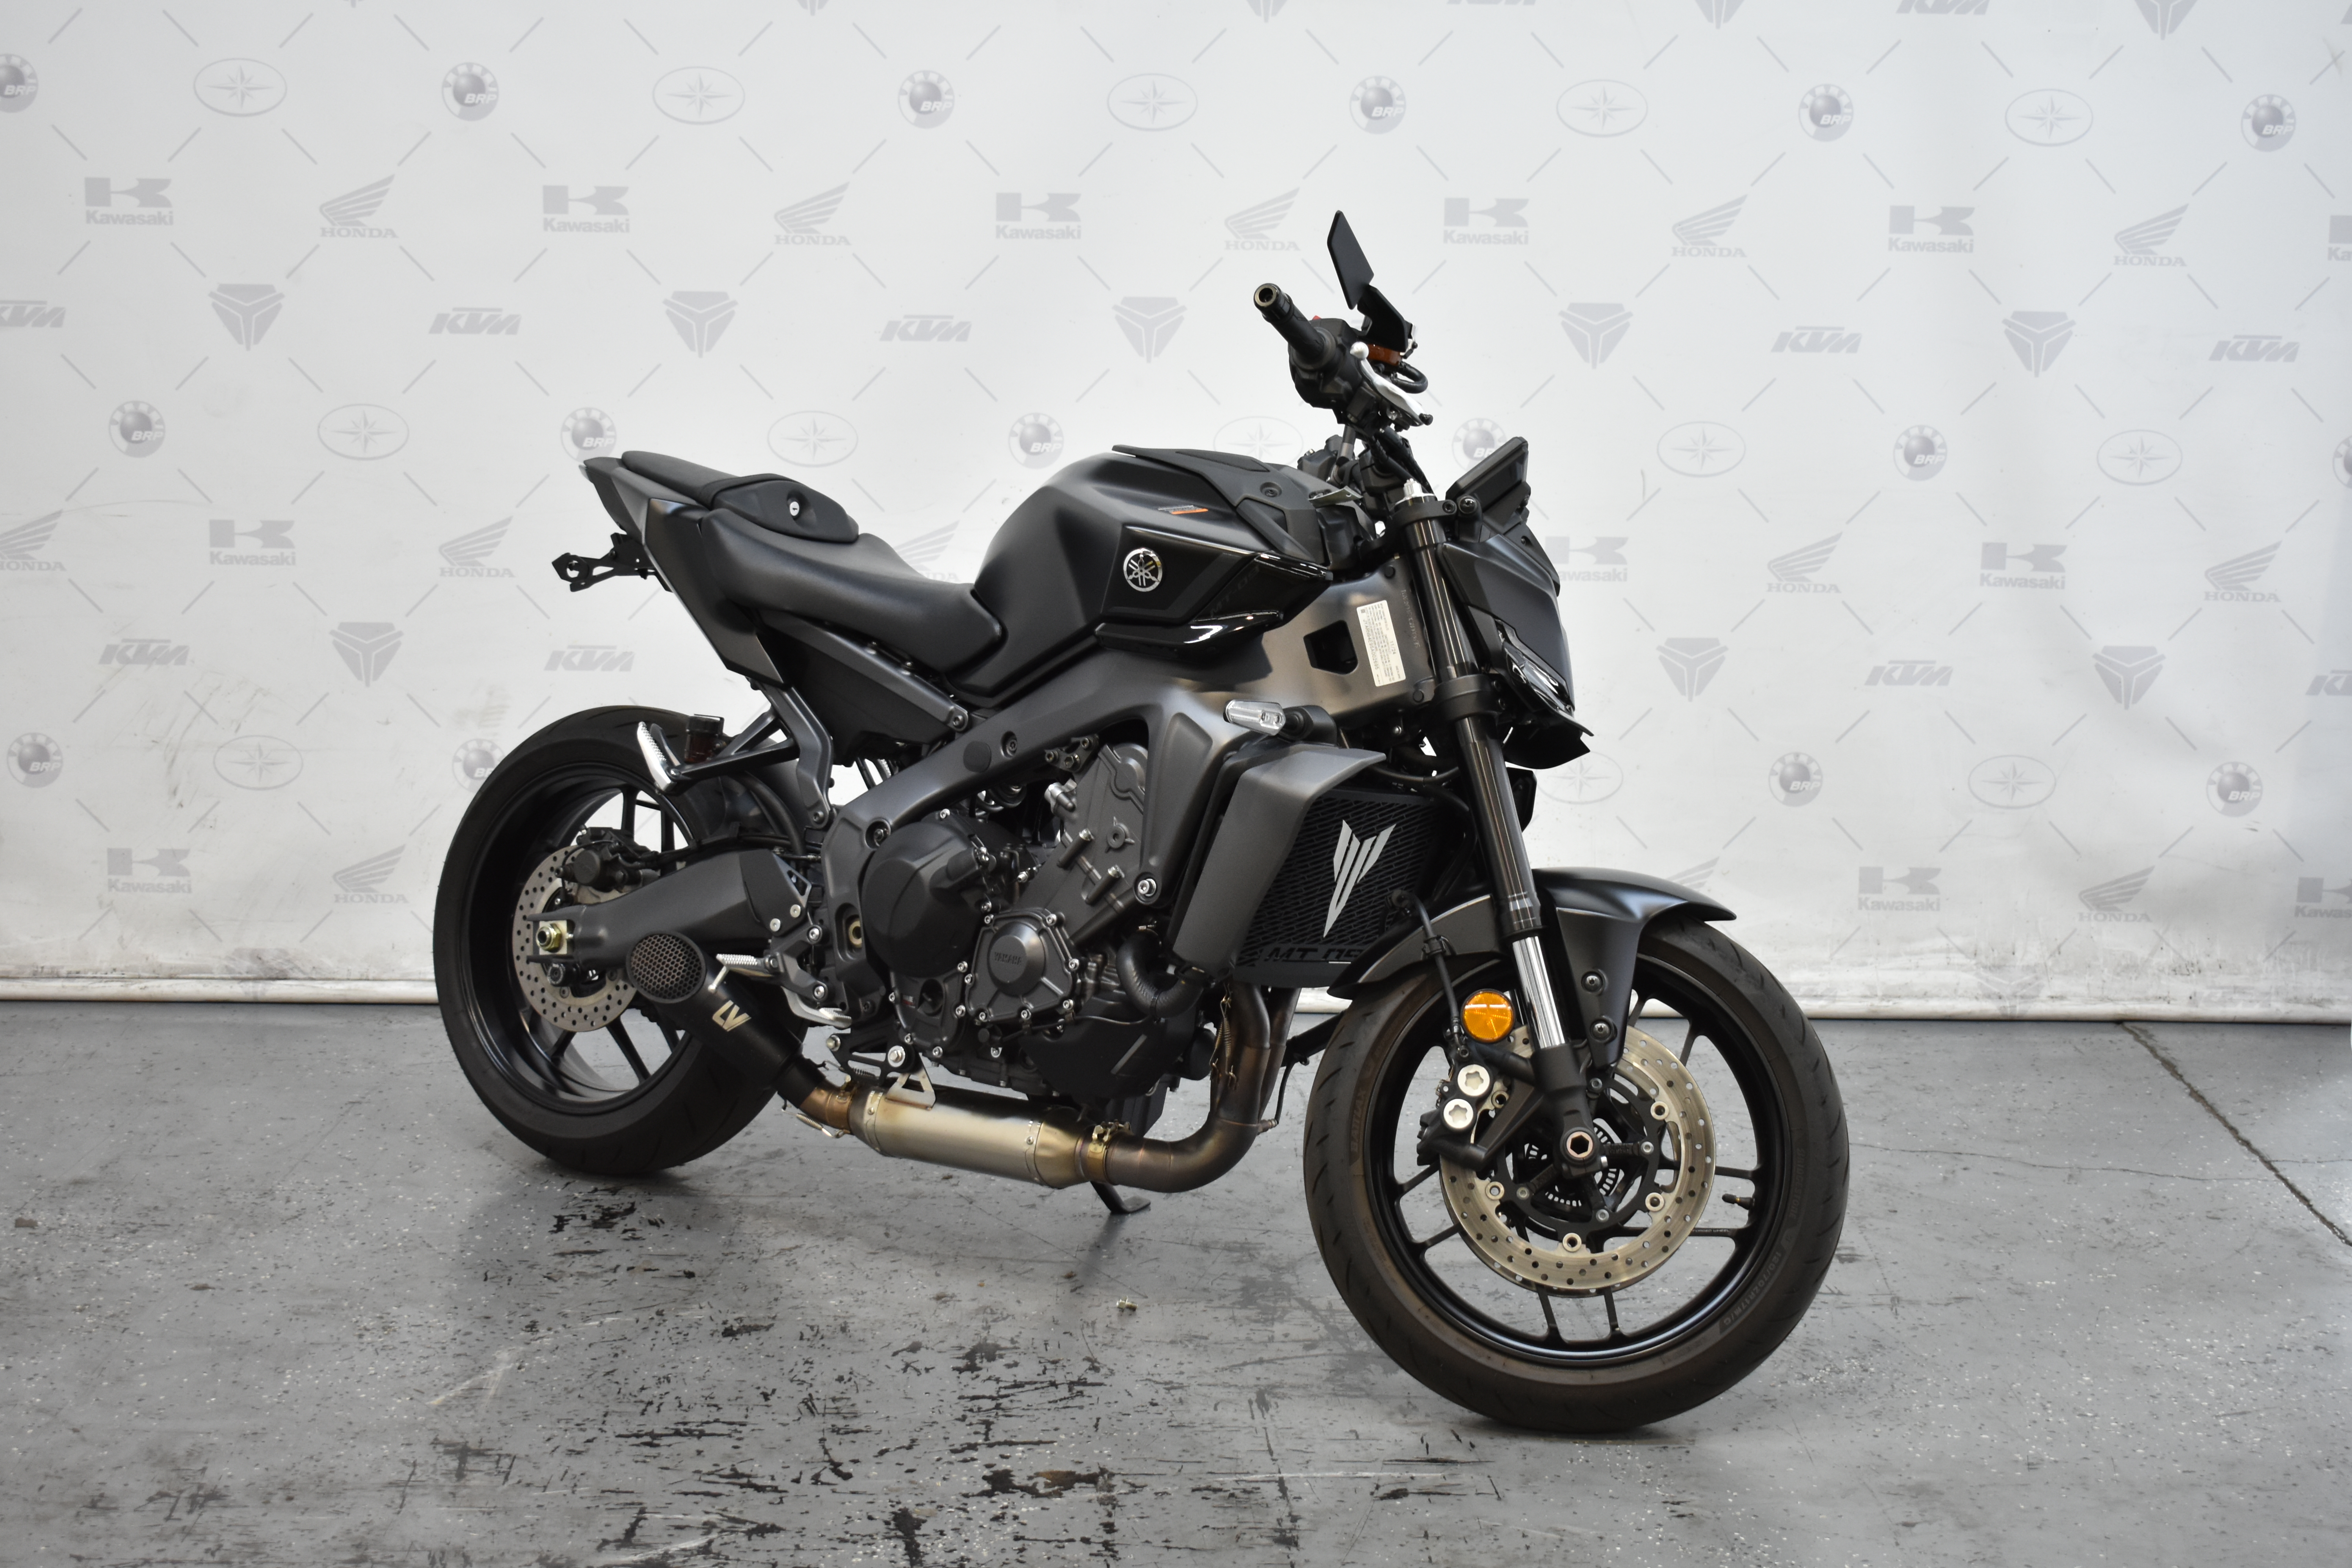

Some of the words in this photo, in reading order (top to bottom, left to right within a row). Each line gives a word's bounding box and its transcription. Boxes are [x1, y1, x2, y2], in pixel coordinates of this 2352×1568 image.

[4, 85, 36, 95] BRP
[465, 94, 496, 104] BRP
[920, 101, 952, 112] BRP
[1372, 107, 1403, 117] BRP
[1820, 115, 1851, 125] BRP
[2262, 125, 2294, 135] BRP
[85, 210, 173, 225] Kawasaki
[543, 218, 629, 232] Kawasaki
[320, 227, 398, 238] HONDA
[996, 225, 1081, 239] Kawasaki
[1443, 230, 1528, 245] Kawasaki
[775, 235, 851, 245] HONDA
[1225, 240, 1300, 250] HONDA
[1888, 238, 1974, 254] Kawasaki
[1672, 247, 1747, 258] HONDA
[2114, 256, 2187, 267] HONDA
[428, 307, 521, 335] KTM
[880, 315, 971, 342] KTM
[1771, 326, 1862, 353] KTM
[2209, 335, 2300, 362] KTM
[132, 430, 163, 441] BRP
[583, 437, 614, 448] BRP
[1031, 442, 1062, 453] BRP
[1914, 454, 1945, 465] BRP
[209, 551, 296, 565] Kawasaki
[439, 566, 515, 577] HONDA
[1559, 568, 1627, 582] awasaki
[1980, 573, 2065, 590] Kawasaki
[1768, 583, 1841, 593] HONDA
[2205, 591, 2281, 602] HONDA
[99, 638, 189, 665] KTM
[544, 644, 634, 671] KTM
[1864, 660, 1953, 686] KTM
[30, 762, 61, 772] BRP
[1790, 781, 1820, 791] BRP
[2229, 791, 2260, 801] BRP
[108, 879, 192, 893] Kawasaki
[334, 893, 408, 904] HONDA
[1858, 897, 1940, 911] Kawasaki
[2079, 912, 2152, 923] HONDA
[1264, 947, 1318, 961] MT
